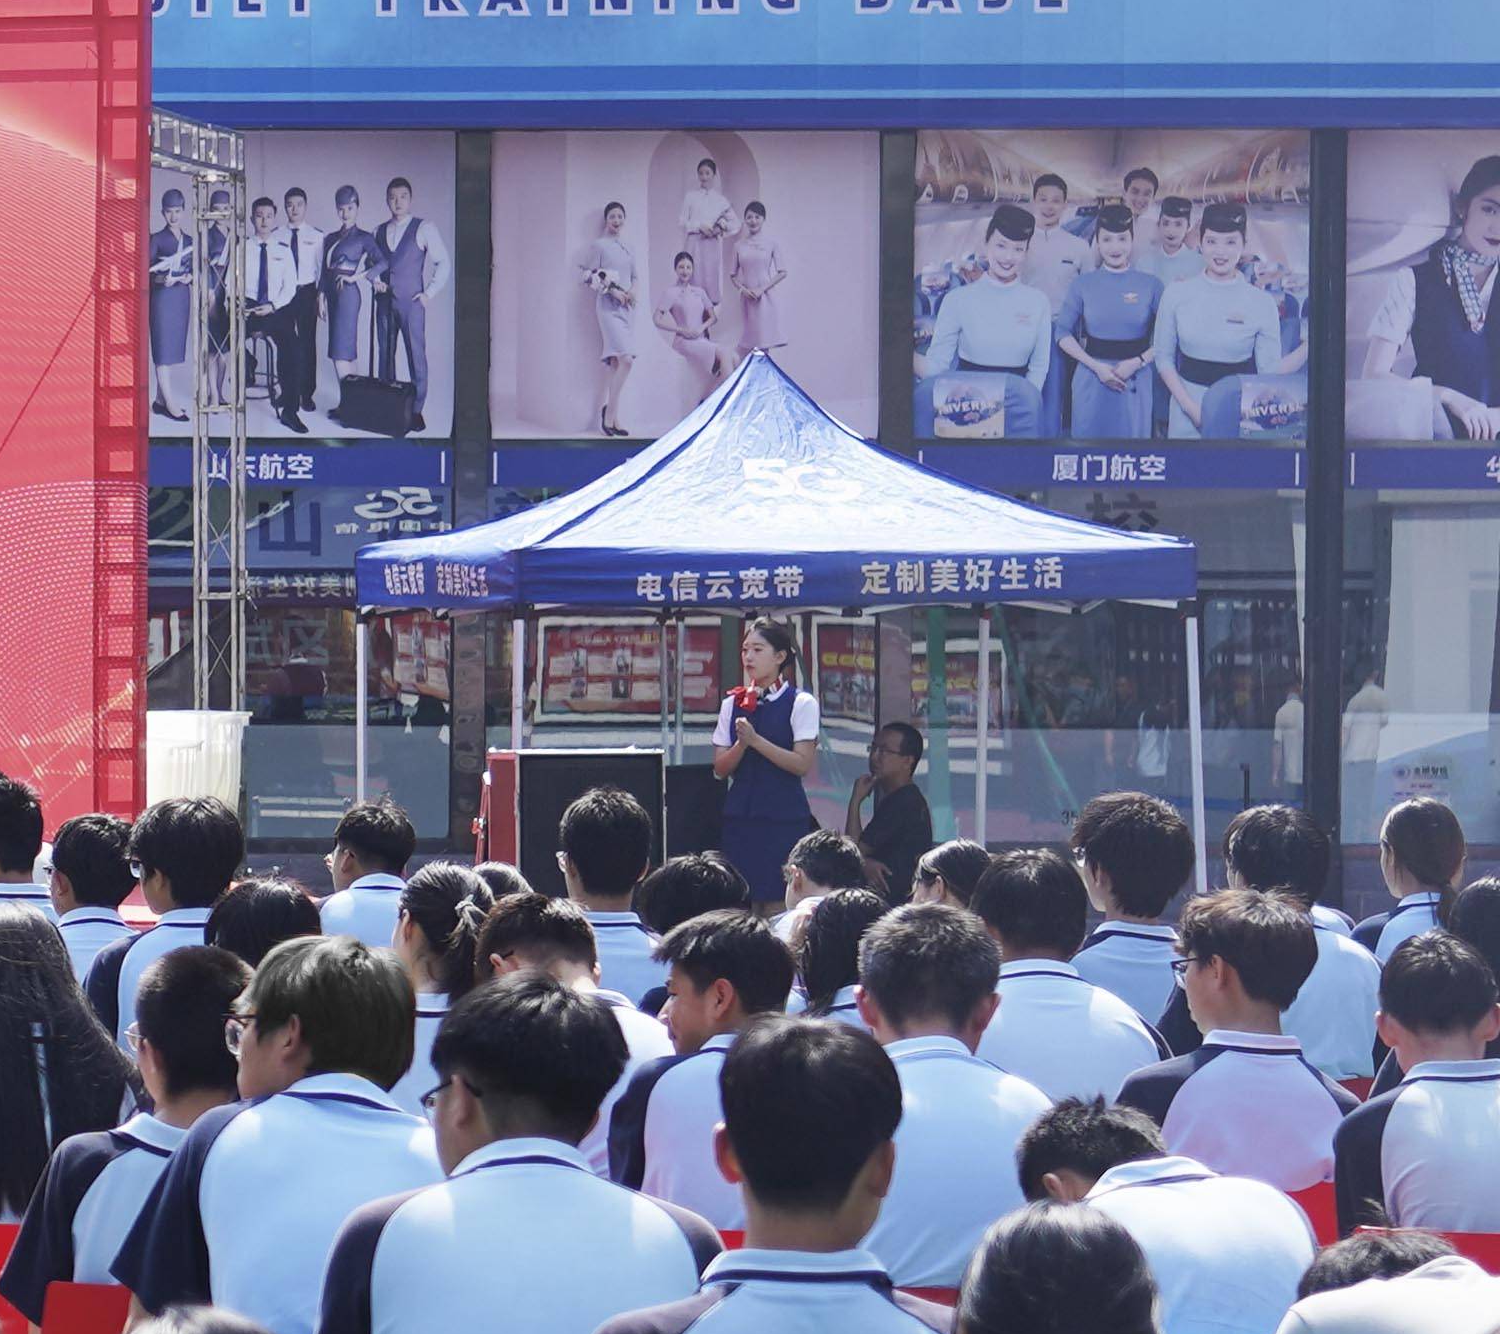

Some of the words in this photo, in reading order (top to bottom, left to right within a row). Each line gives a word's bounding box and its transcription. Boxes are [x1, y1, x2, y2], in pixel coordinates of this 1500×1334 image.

[1052, 454, 1167, 482] 厦门航空
[635, 566, 803, 603] 电信云宽带
[860, 556, 1064, 596] 定制美好生活
